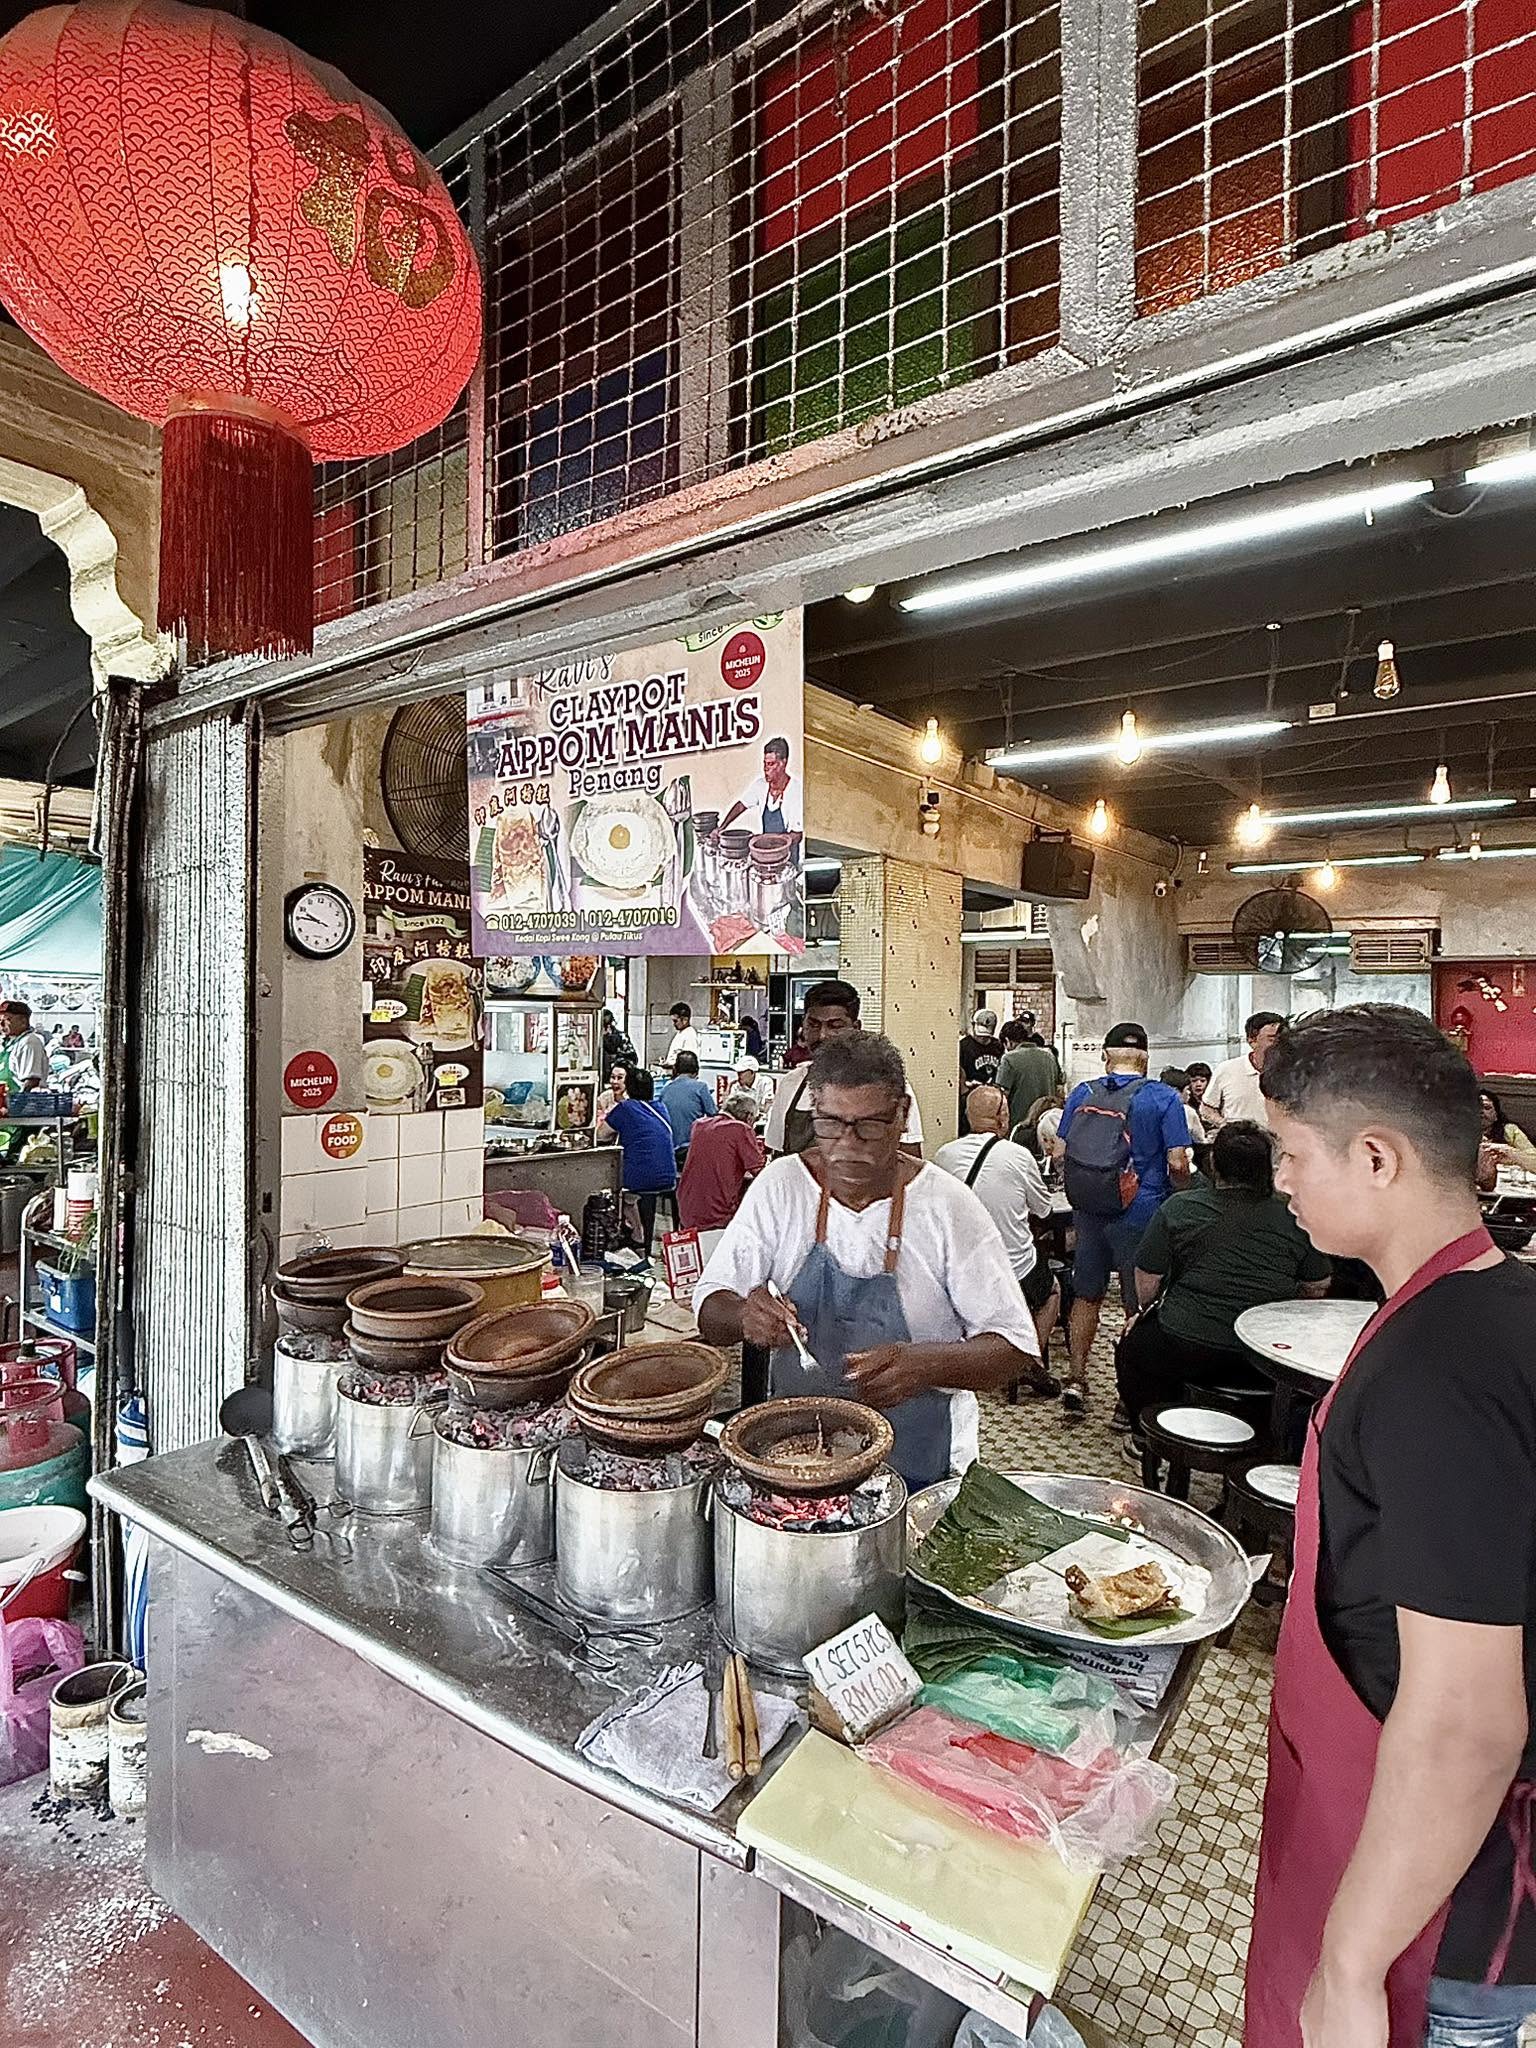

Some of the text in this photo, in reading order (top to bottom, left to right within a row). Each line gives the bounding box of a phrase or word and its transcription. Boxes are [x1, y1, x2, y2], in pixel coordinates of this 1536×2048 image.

[725, 655, 761, 670] MICHELIN
[734, 668, 751, 679] 2025
[550, 673, 686, 728] CLAYPOT
[497, 697, 760, 777] APPOM MANIS
[569, 765, 663, 794] Penang
[379, 860, 422, 887] Ravi's
[363, 881, 425, 904] APPOM
[428, 891, 471, 910] MANI
[404, 920, 425, 928] Since
[501, 907, 677, 931] 012-4707039 012-4707019
[290, 1075, 333, 1088] MICHELIN
[302, 1087, 322, 1097] 2025
[328, 1121, 357, 1134] BEST
[327, 1135, 358, 1148] FOOD
[815, 1656, 837, 1690] 1
[827, 1639, 861, 1680] SET
